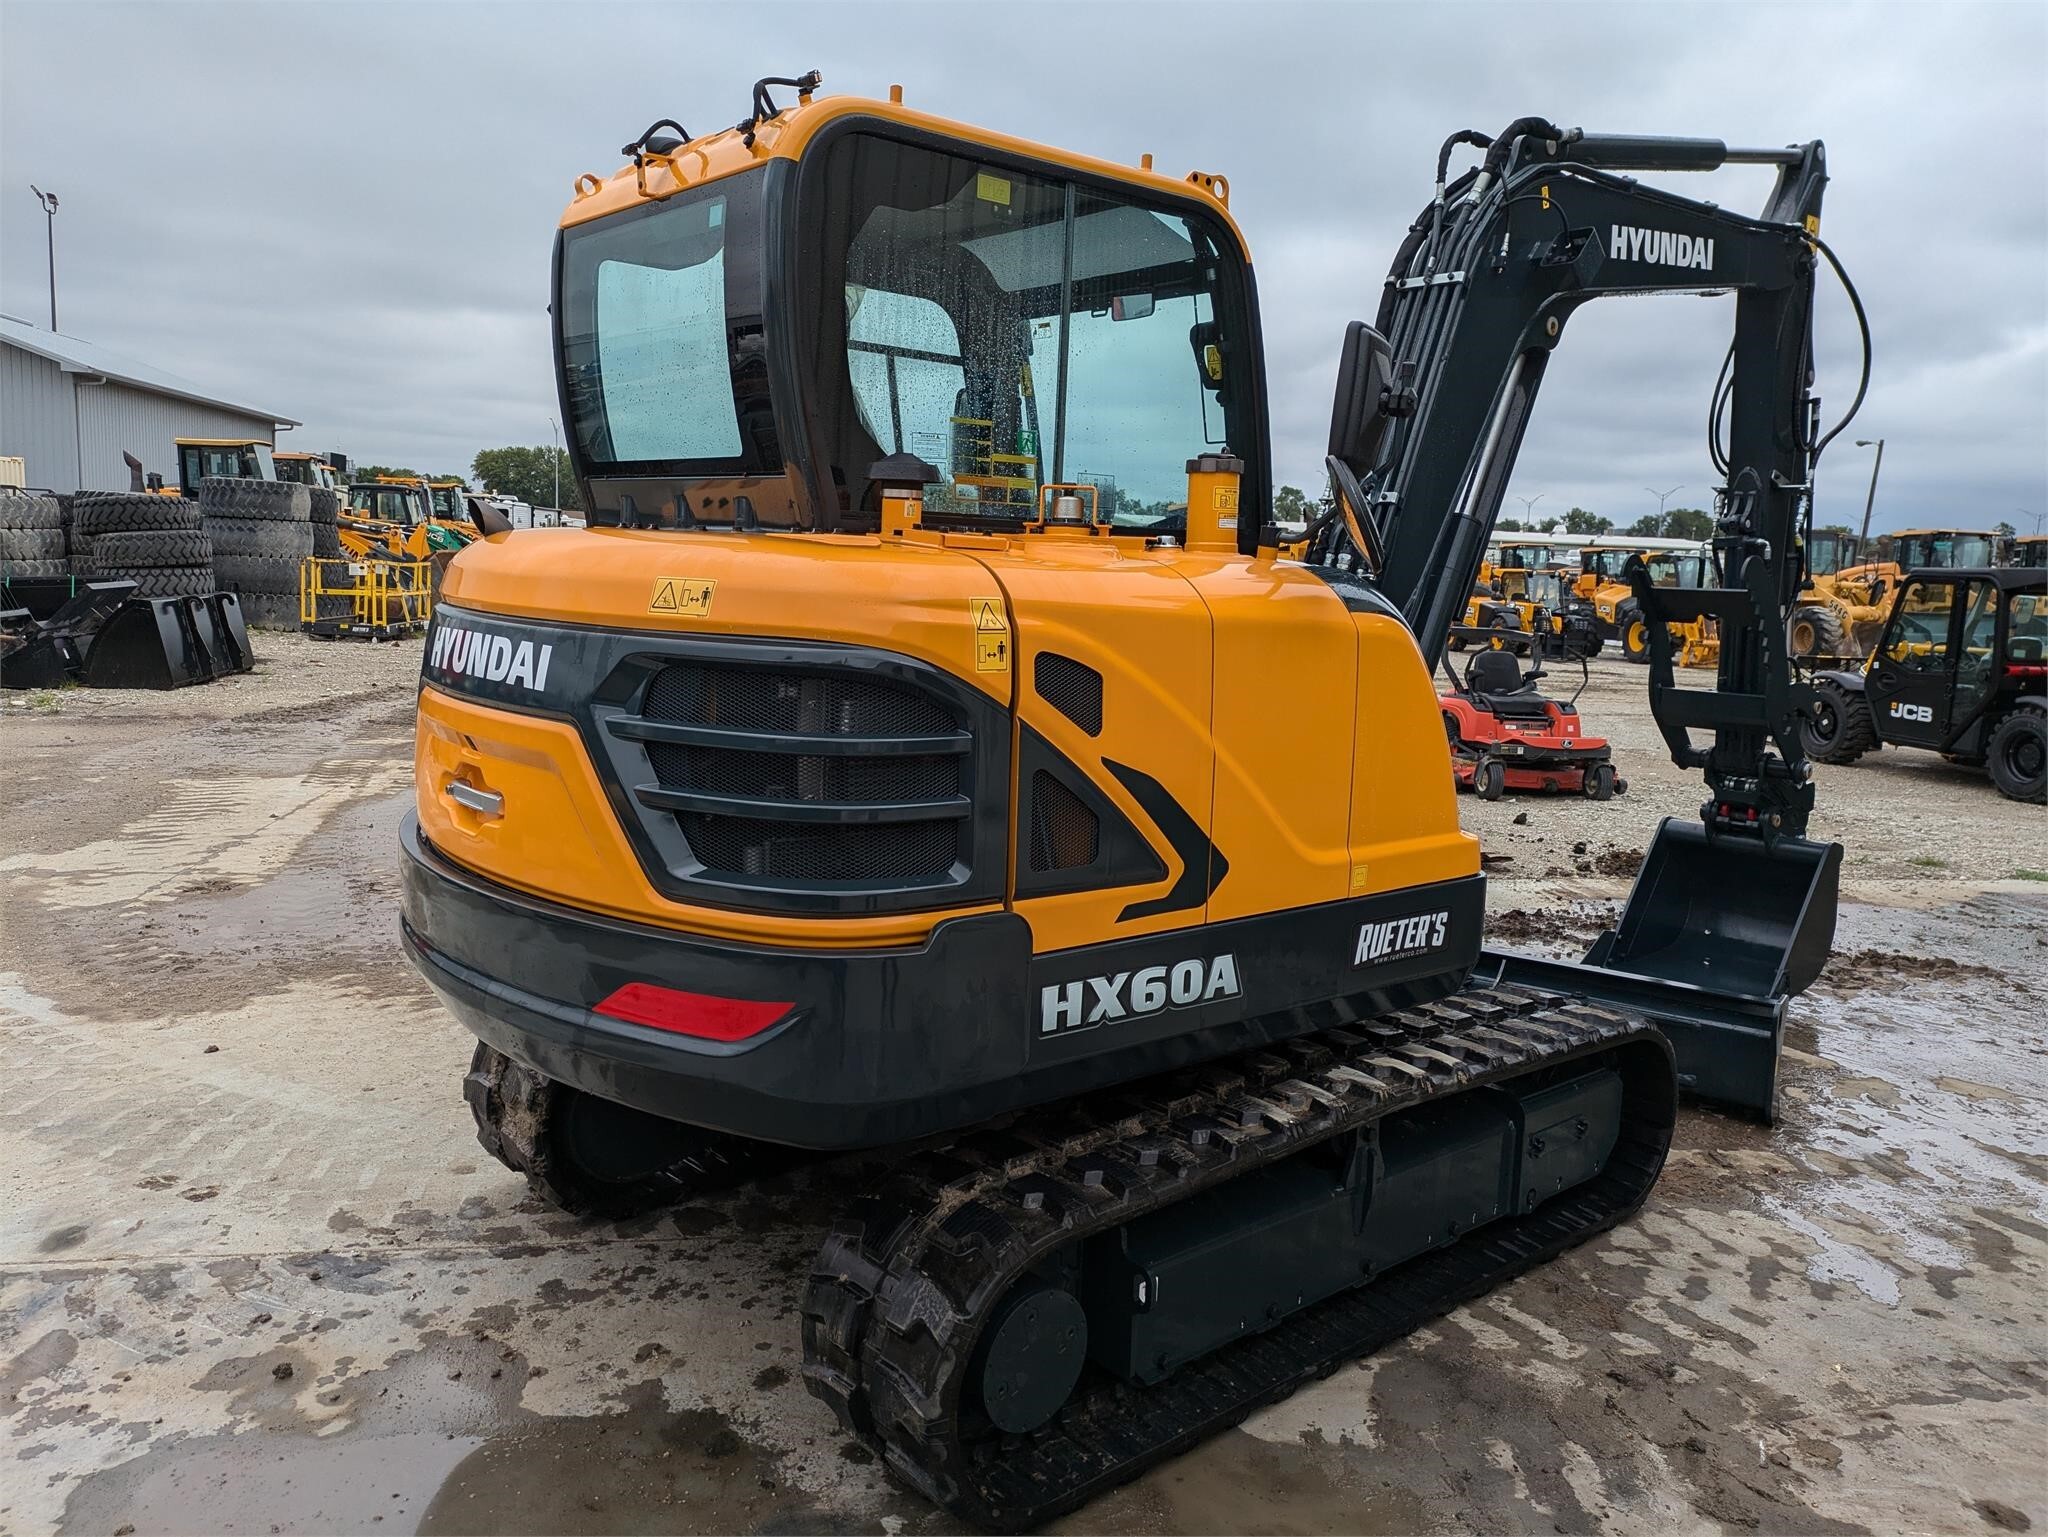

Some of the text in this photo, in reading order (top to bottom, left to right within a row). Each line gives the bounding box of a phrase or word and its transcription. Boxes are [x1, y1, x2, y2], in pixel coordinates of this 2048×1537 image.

[1610, 224, 1714, 271] HYUNDAI
[430, 625, 553, 692] HYUNDAI
[1890, 702, 1934, 723] JCB
[1354, 911, 1449, 966] RUETER'S
[1041, 954, 1239, 1033] HX60A
